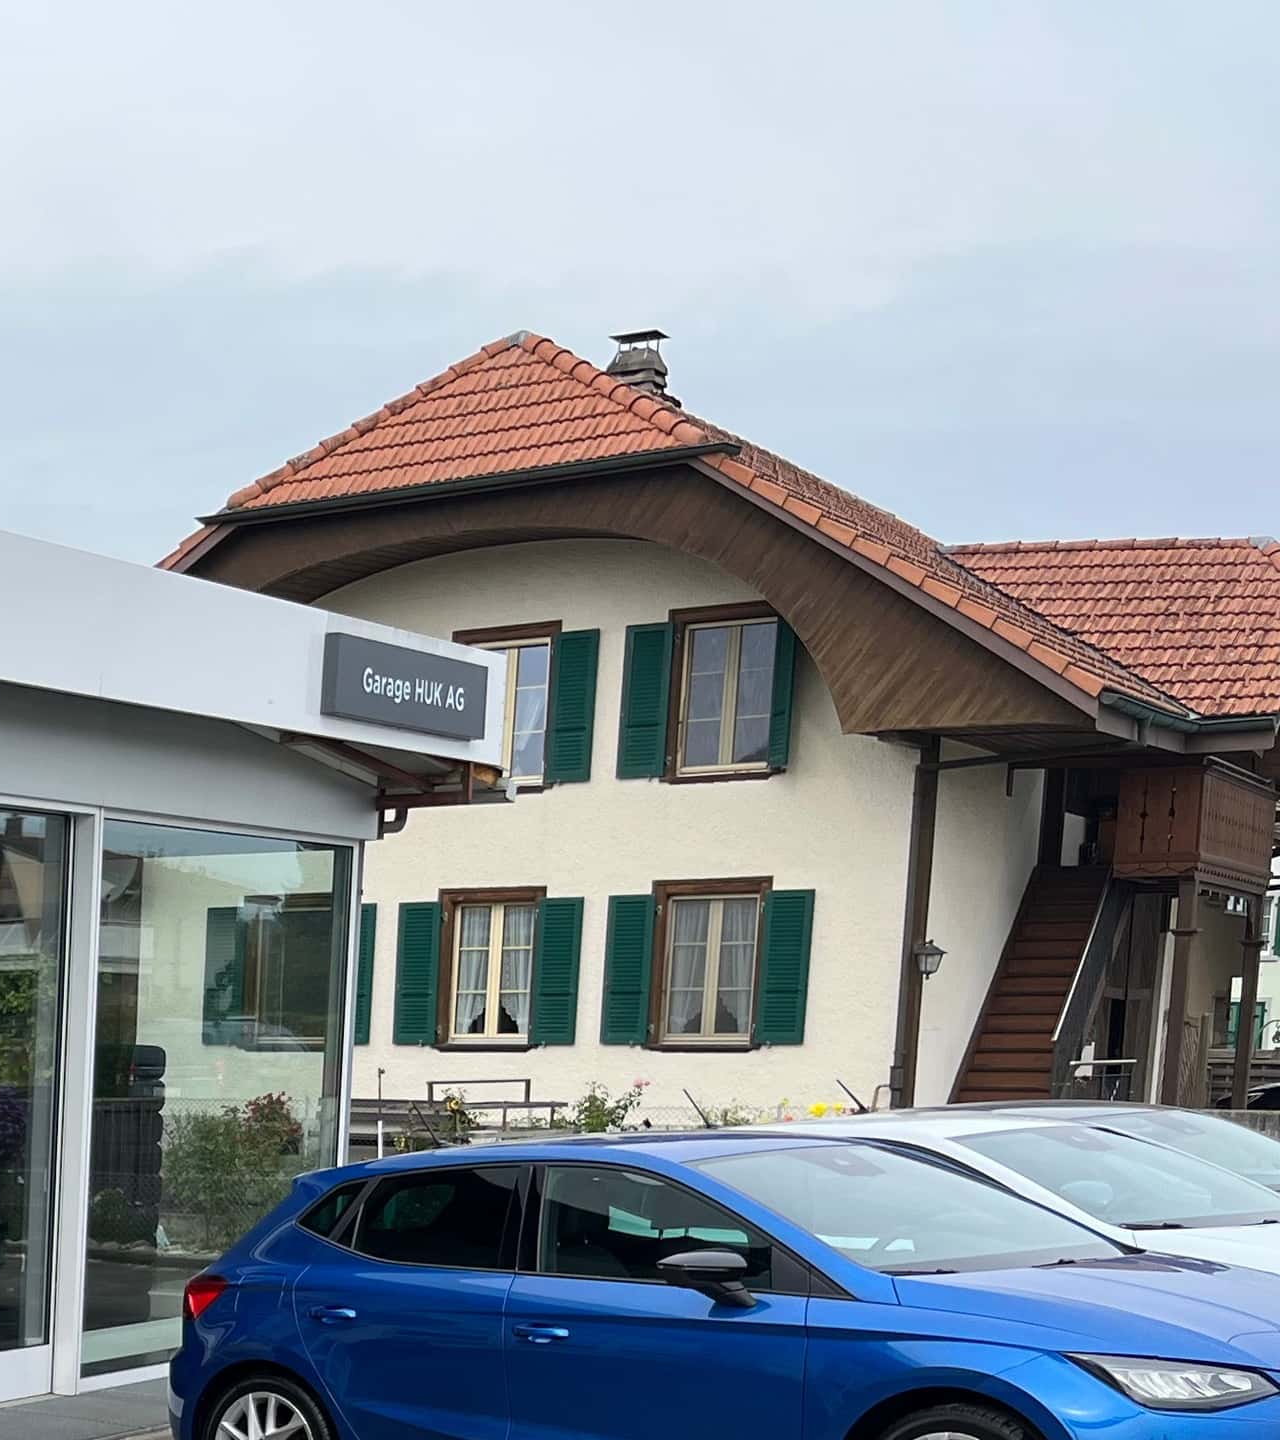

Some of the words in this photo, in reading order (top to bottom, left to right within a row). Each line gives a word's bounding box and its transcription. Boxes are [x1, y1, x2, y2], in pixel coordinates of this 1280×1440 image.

[362, 667, 411, 704] Garage
[414, 678, 442, 707] HUK
[445, 685, 465, 711] AG
